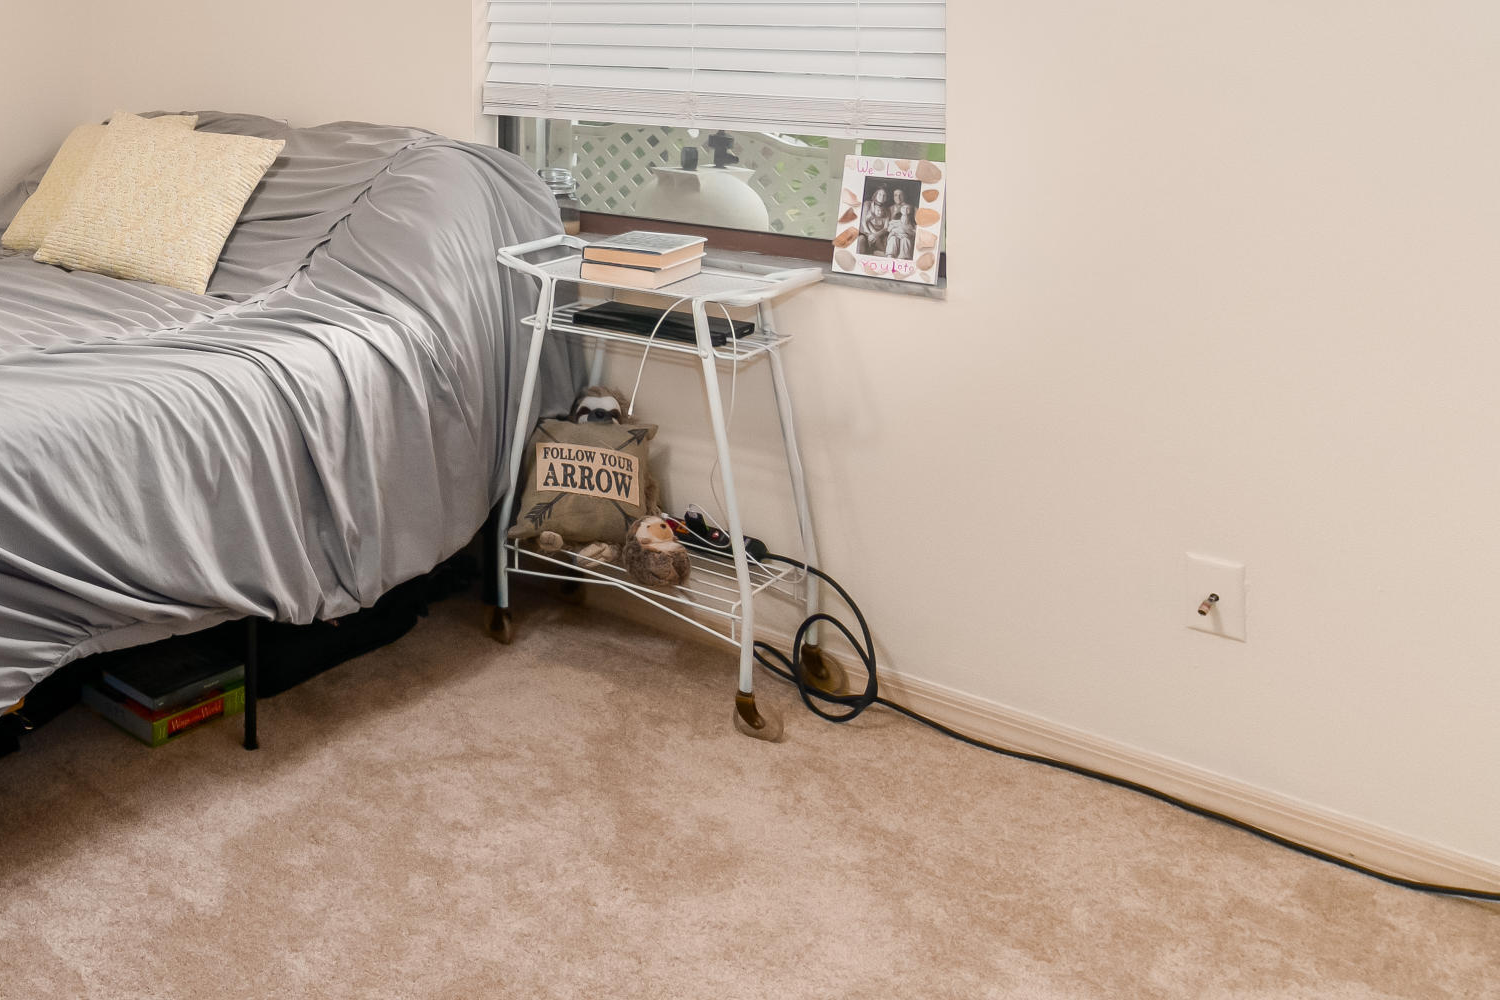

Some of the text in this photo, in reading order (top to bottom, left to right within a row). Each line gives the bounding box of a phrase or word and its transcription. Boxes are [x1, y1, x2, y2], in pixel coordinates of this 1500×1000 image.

[856, 159, 913, 178] We Love
[861, 260, 889, 273] You
[543, 447, 633, 472] FOLLOW YOUR
[543, 462, 633, 499] ARROW
